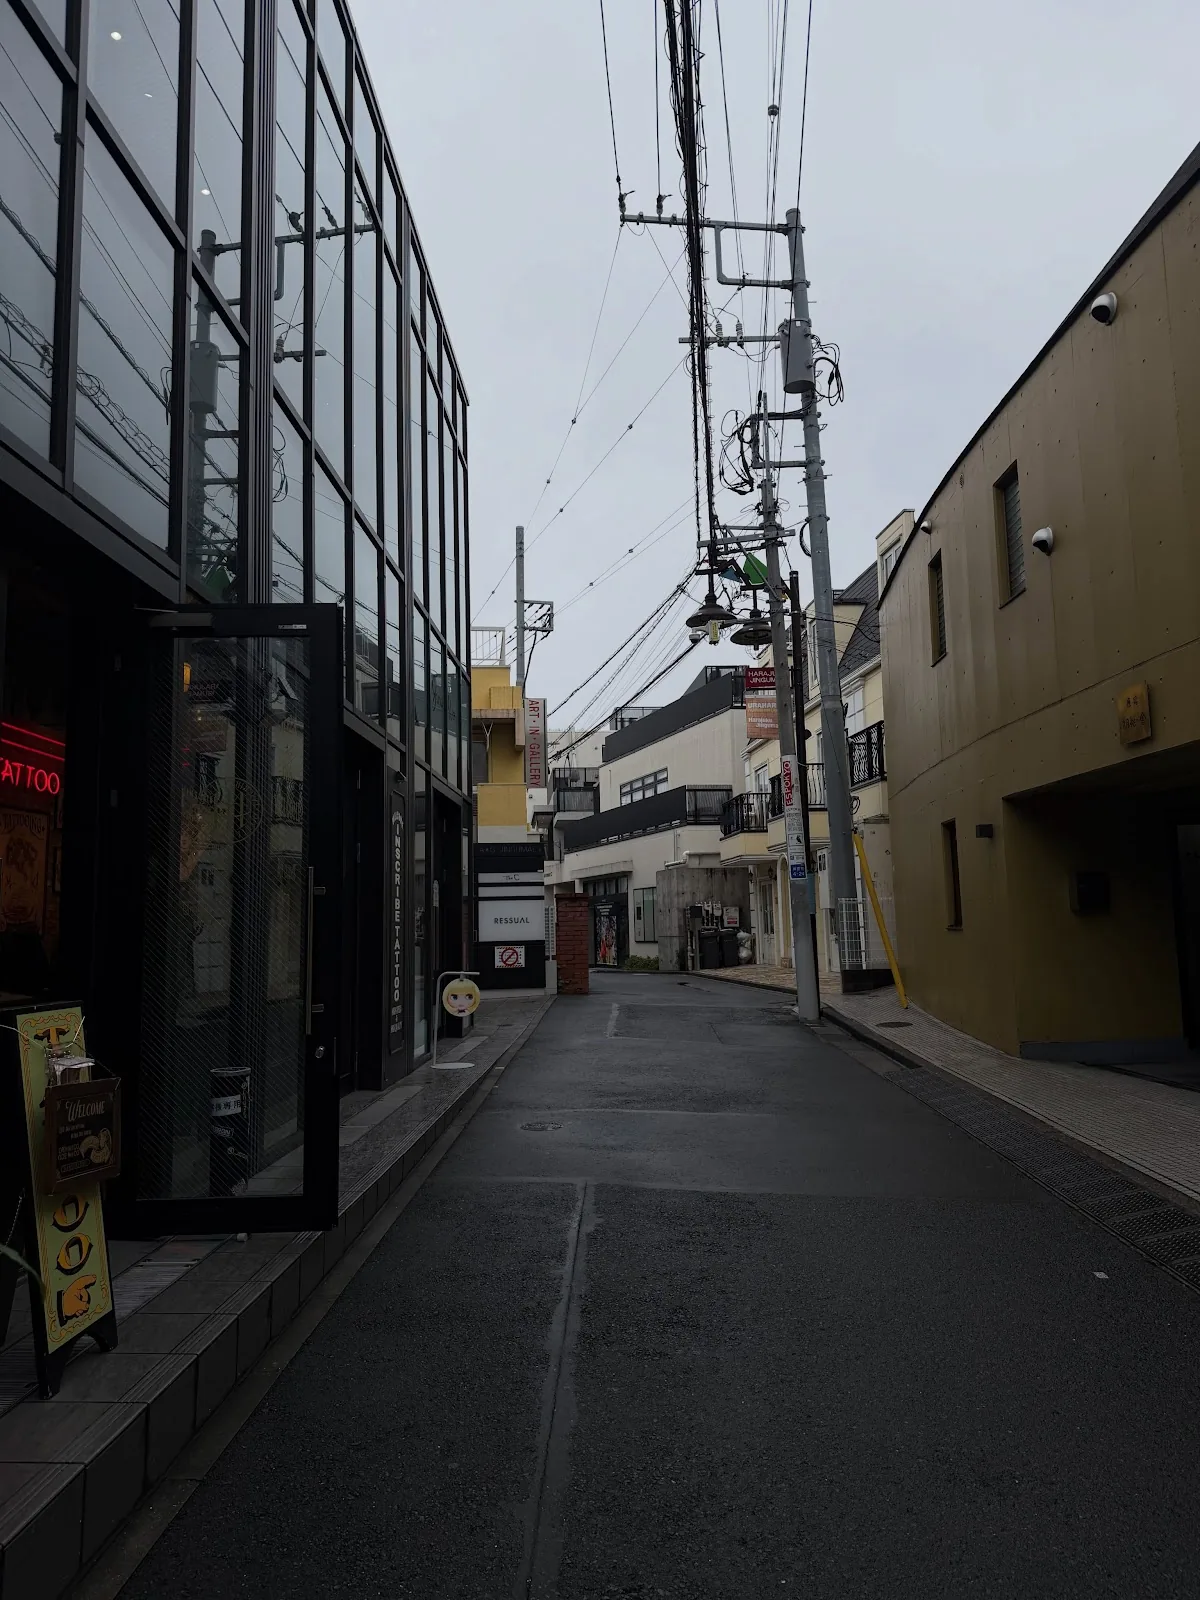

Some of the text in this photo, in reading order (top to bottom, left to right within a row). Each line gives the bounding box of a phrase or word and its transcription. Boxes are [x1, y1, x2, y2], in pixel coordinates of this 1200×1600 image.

[528, 699, 540, 718] ART
[0, 757, 60, 795] ATTOO
[527, 743, 542, 788] GALLERY
[494, 917, 530, 925] RESSUAL
